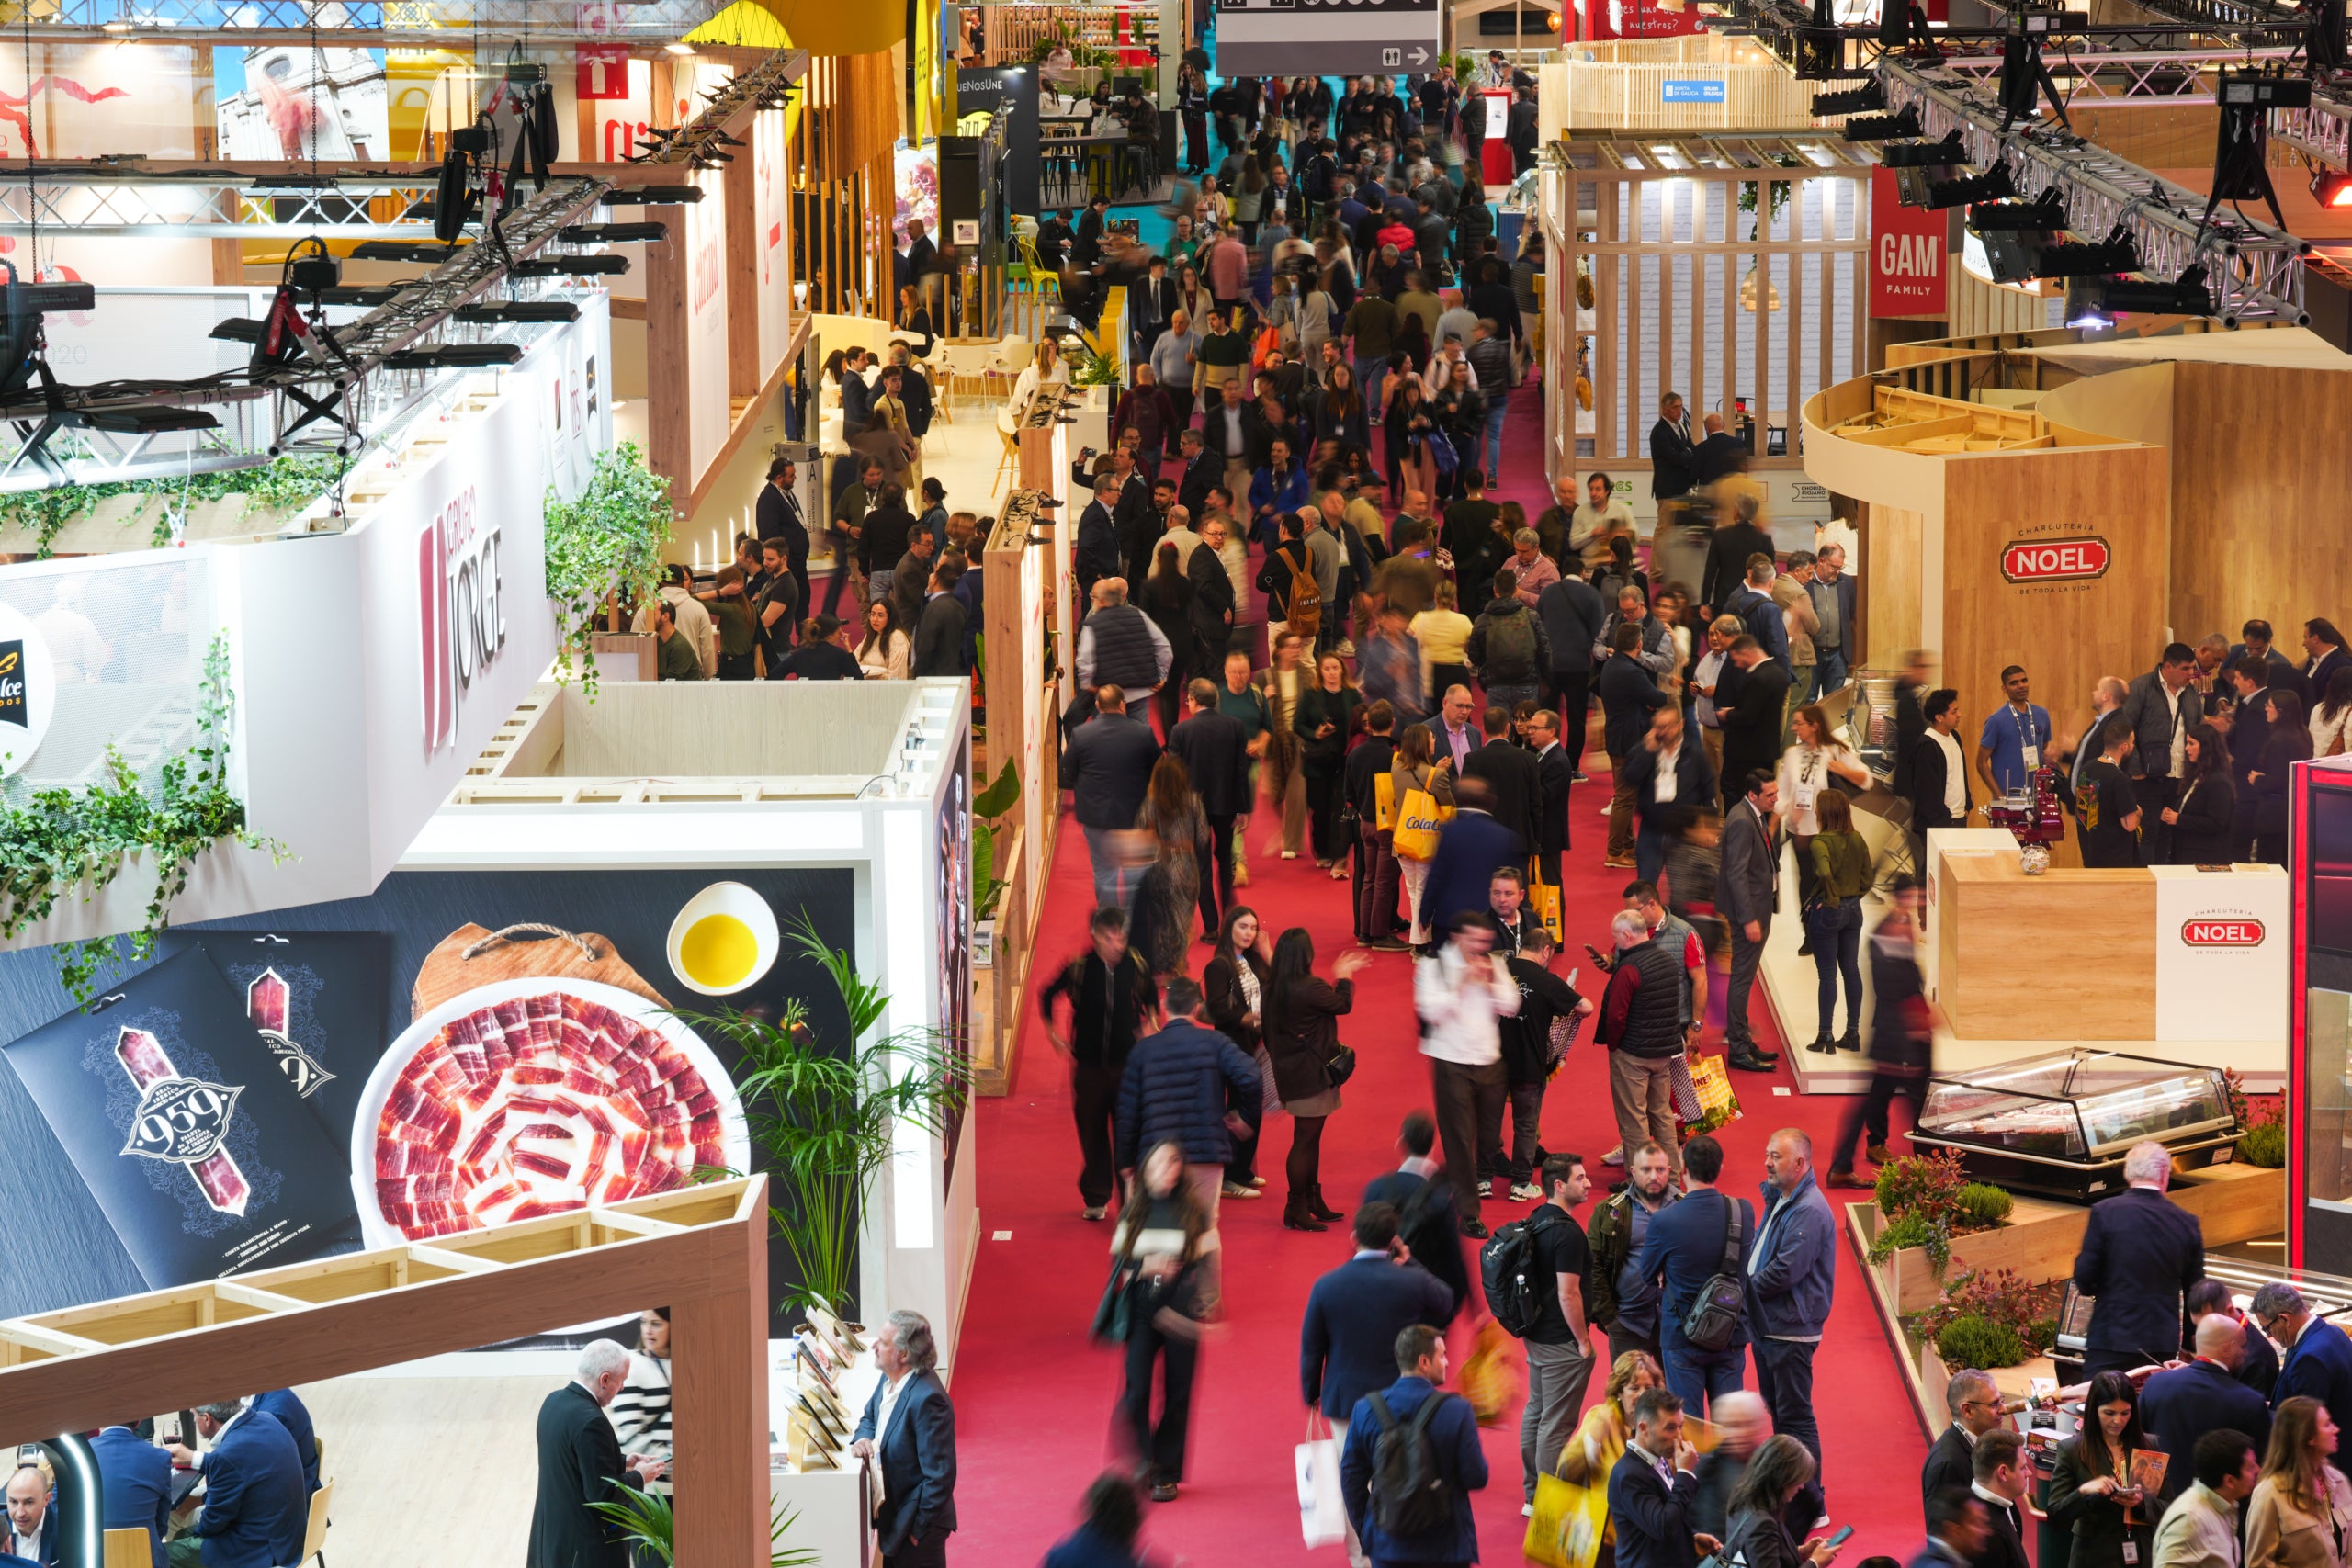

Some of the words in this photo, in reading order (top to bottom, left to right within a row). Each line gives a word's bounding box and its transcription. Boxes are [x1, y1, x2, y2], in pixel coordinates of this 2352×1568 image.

[1629, 17, 1679, 32] nuestros?
[1880, 233, 1938, 277] GAM
[1886, 285, 1931, 296] FAMILY
[447, 484, 476, 555] GRUPO
[2018, 523, 2094, 536] CHARCUTERÍA
[2017, 548, 2094, 573] NOEL
[447, 525, 506, 746] JORGE
[1406, 816, 1442, 831] ColaC
[2193, 925, 2253, 941] NOEL
[139, 1088, 223, 1154] 959
[180, 1128, 202, 1142] PALETA
[185, 1129, 210, 1145] BELLOTA
[298, 1224, 311, 1235] PORK
[224, 1246, 241, 1258] CORTE
[240, 1229, 269, 1248] TRADICIONAL
